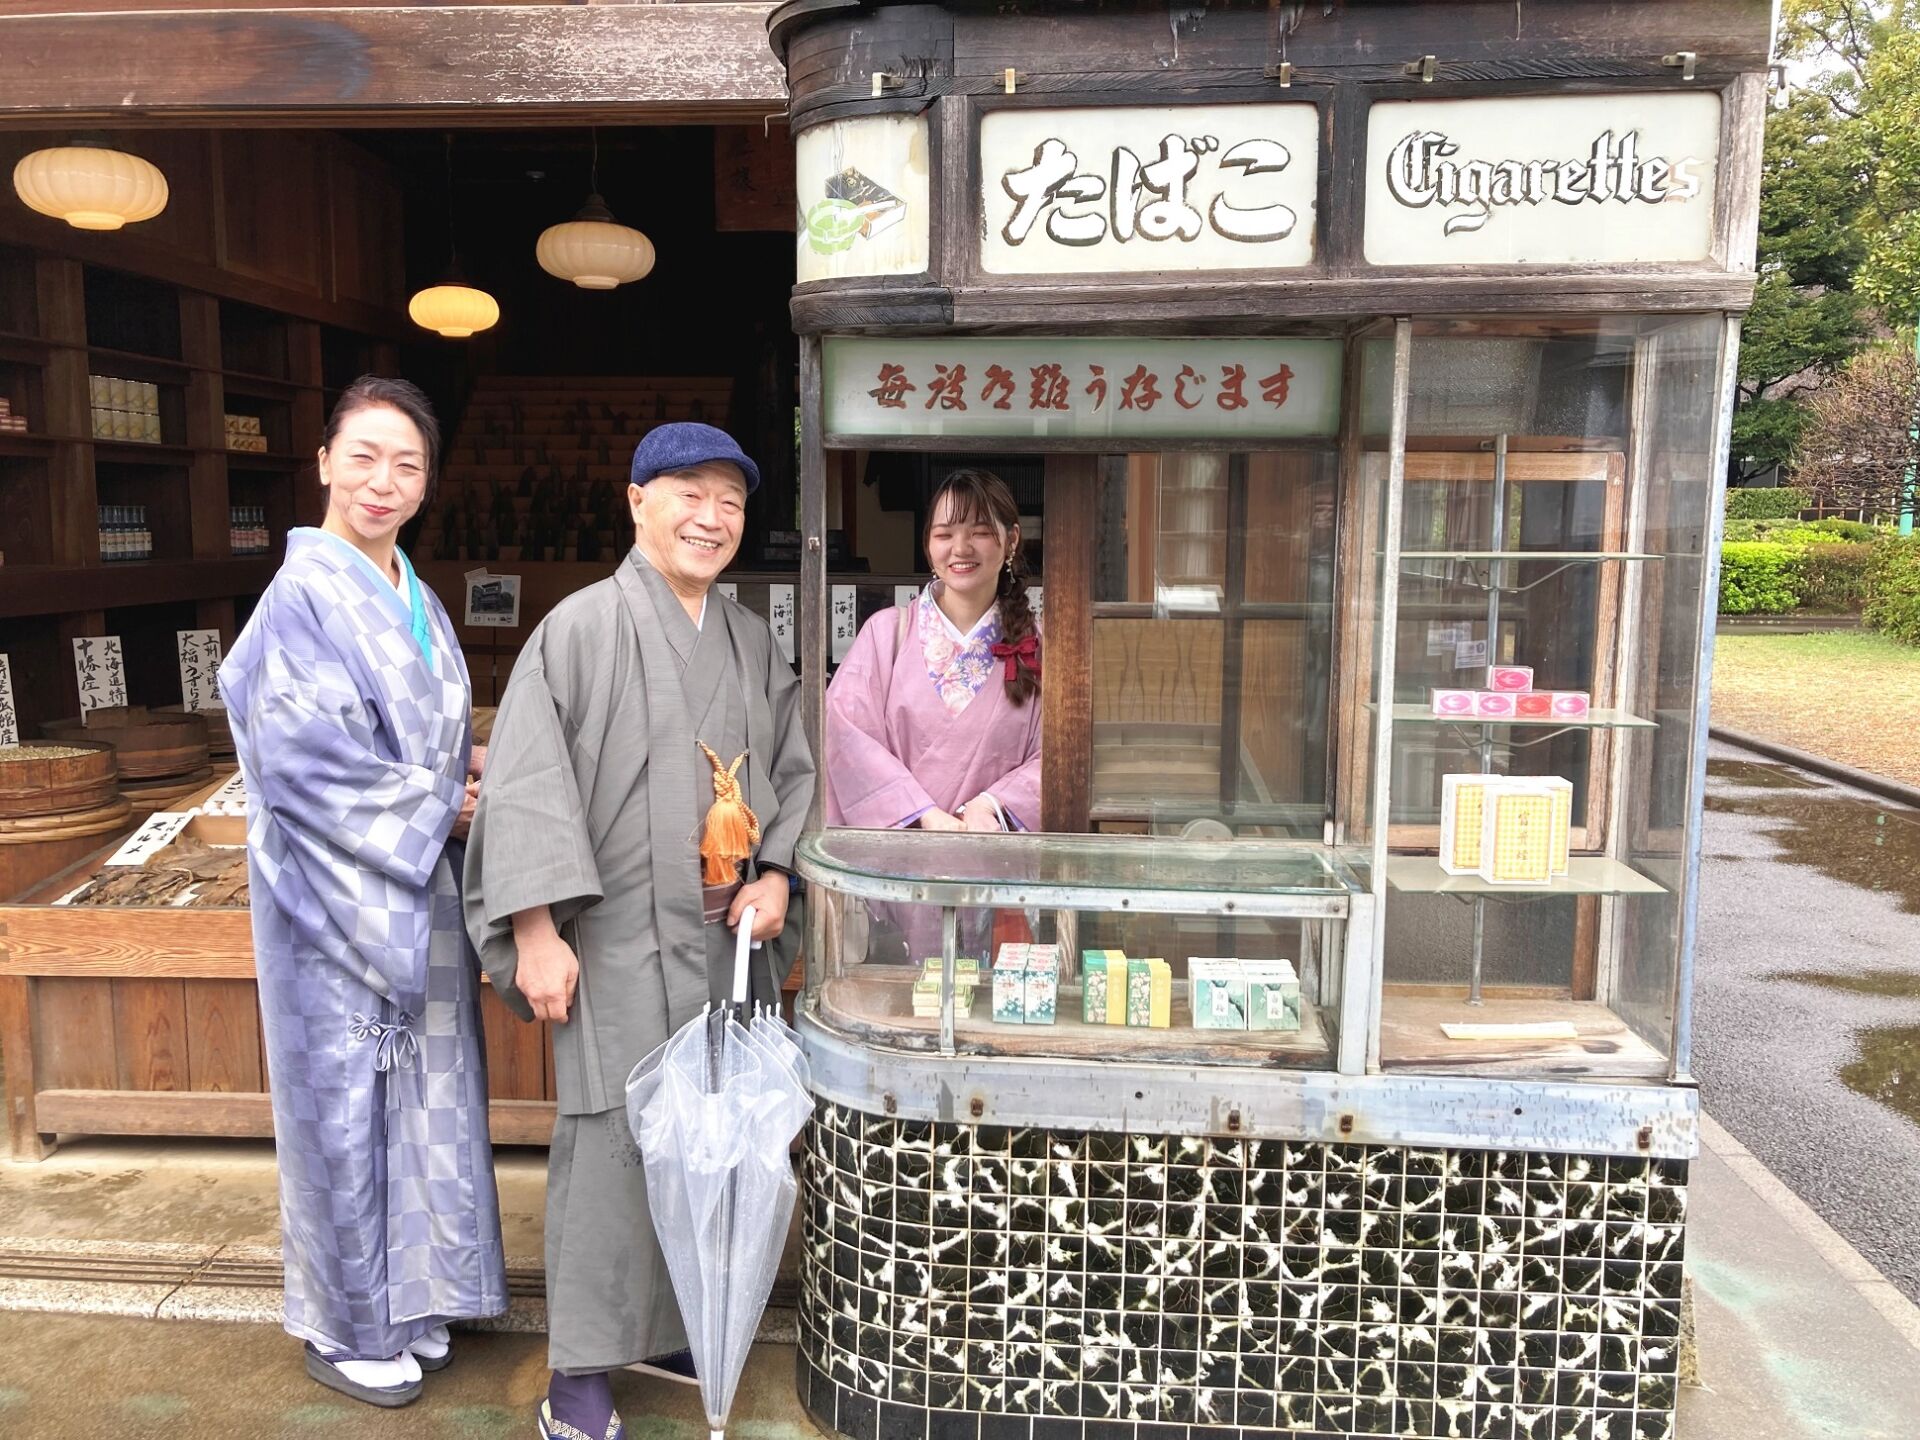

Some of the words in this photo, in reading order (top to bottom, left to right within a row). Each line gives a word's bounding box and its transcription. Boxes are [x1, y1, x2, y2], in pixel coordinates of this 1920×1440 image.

[1001, 134, 1297, 247] たばこ
[1386, 129, 1703, 237] Cigarettes
[774, 603, 786, 637] 海苔
[835, 600, 849, 640] 海苔
[76, 638, 105, 709] 十勝産小
[104, 640, 126, 708] 北海道特
[125, 820, 168, 855] スルメ
